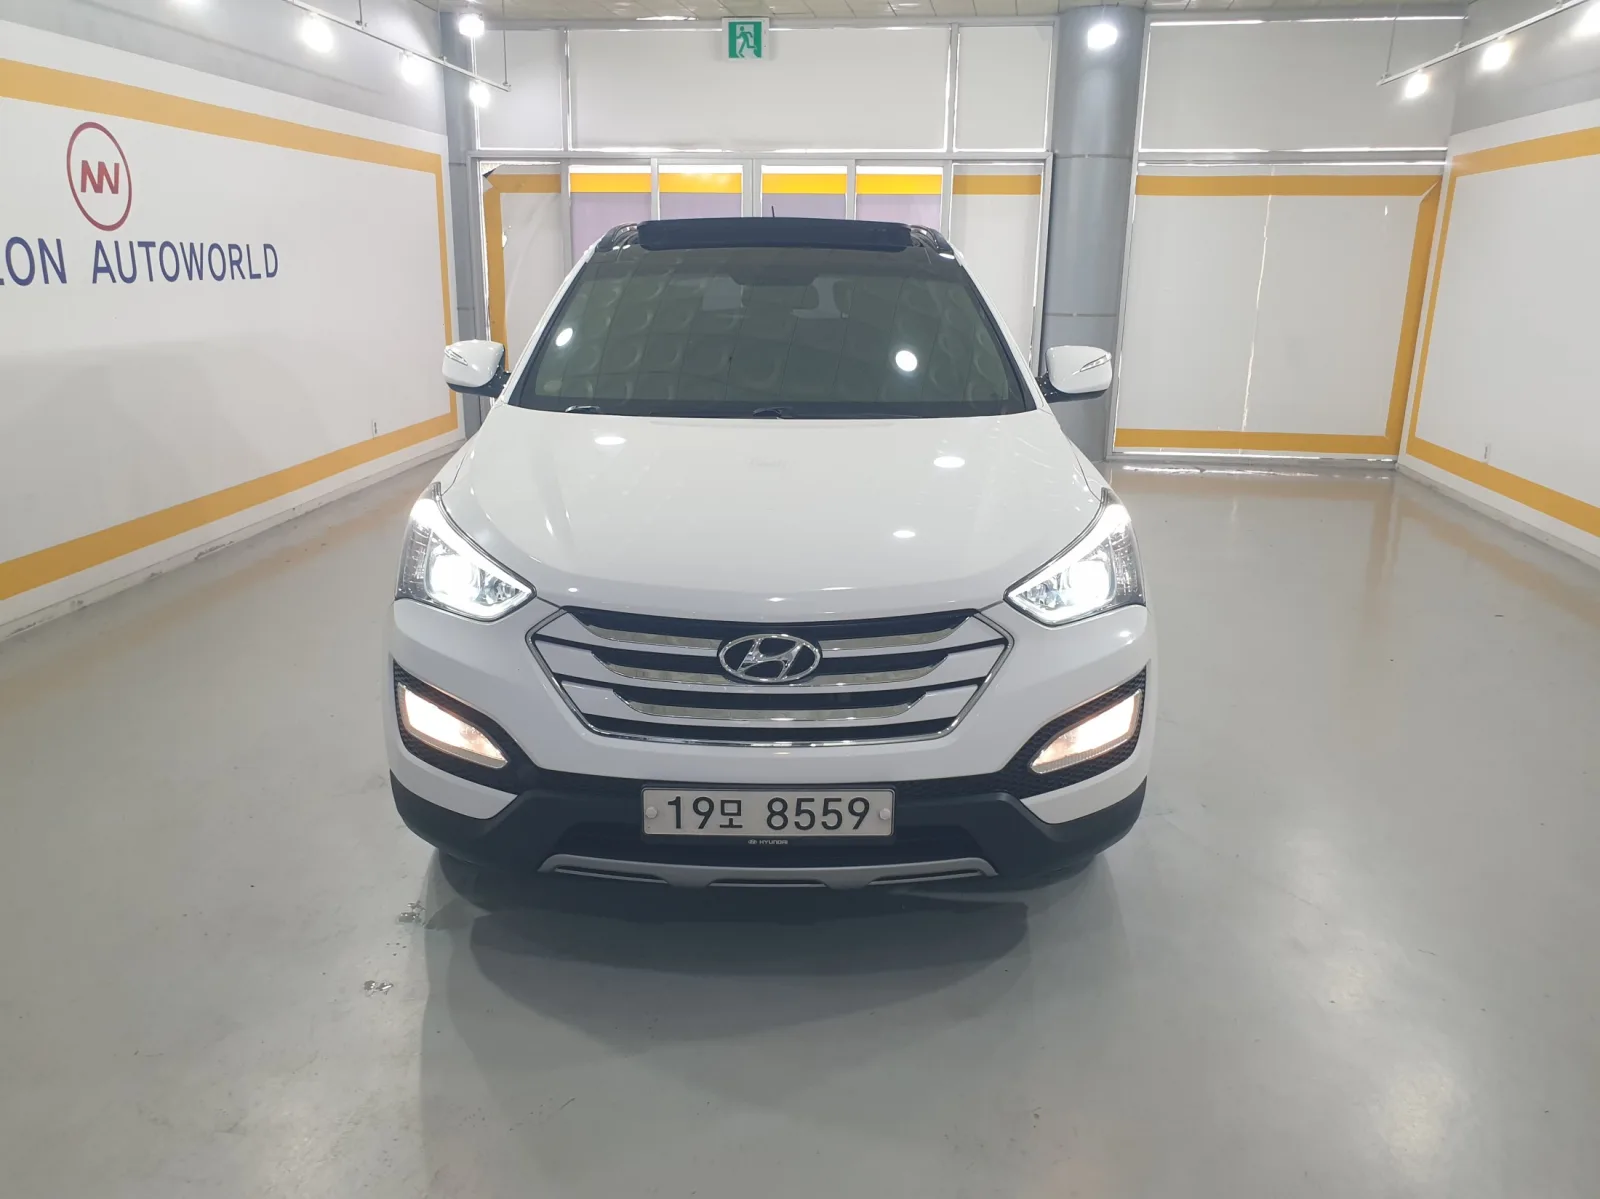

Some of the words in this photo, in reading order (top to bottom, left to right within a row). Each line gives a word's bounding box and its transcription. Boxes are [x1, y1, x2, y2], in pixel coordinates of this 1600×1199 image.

[0, 236, 67, 287] ON
[92, 239, 279, 284] AUTOWORLD
[667, 795, 743, 830] 19모
[766, 796, 870, 831] 8559
